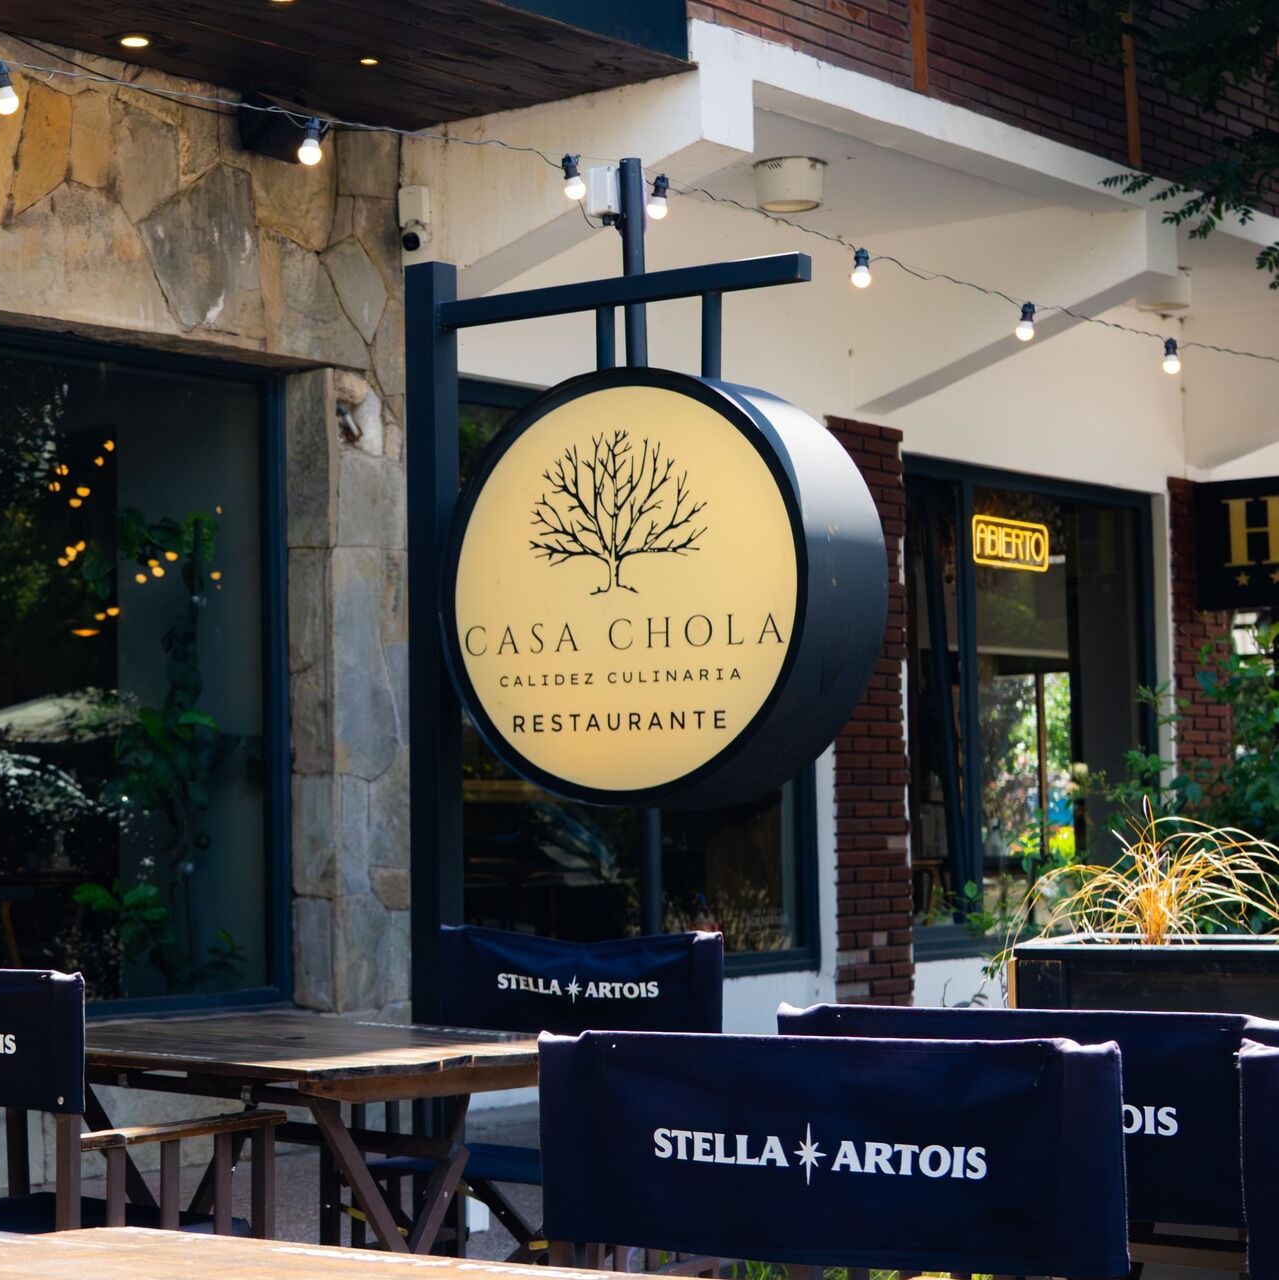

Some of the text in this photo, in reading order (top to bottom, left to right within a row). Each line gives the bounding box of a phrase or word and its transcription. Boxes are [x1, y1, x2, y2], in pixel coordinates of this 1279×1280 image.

[976, 523, 1045, 562] ABIERTO
[464, 612, 785, 657] CASA CHOLA
[499, 667, 742, 688] CALIDEZ CULINARIA
[512, 709, 728, 734] RESTAURANTE
[497, 973, 660, 999] STELLA ARTOIS
[1121, 1103, 1179, 1137] OIS
[654, 1128, 987, 1180] STELLA ARTOIS
